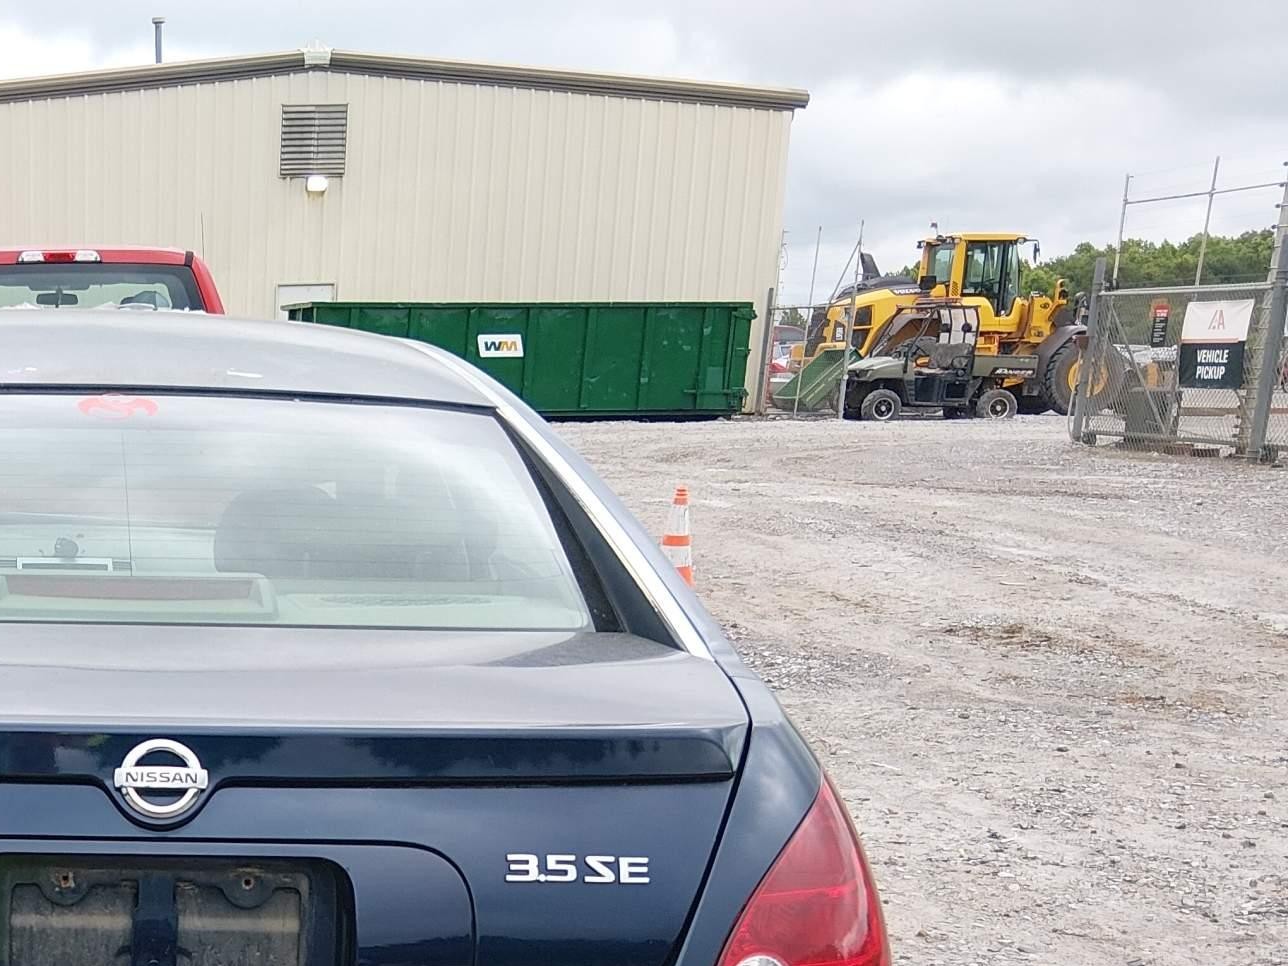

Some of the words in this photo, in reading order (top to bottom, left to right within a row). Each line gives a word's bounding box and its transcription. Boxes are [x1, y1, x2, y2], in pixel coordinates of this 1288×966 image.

[484, 341, 518, 351] WM
[1197, 349, 1229, 363] VEHICLE
[1195, 366, 1226, 379] PICKUP
[125, 772, 198, 784] NISSAN
[505, 854, 577, 882] 3.5
[584, 856, 650, 883] SE
